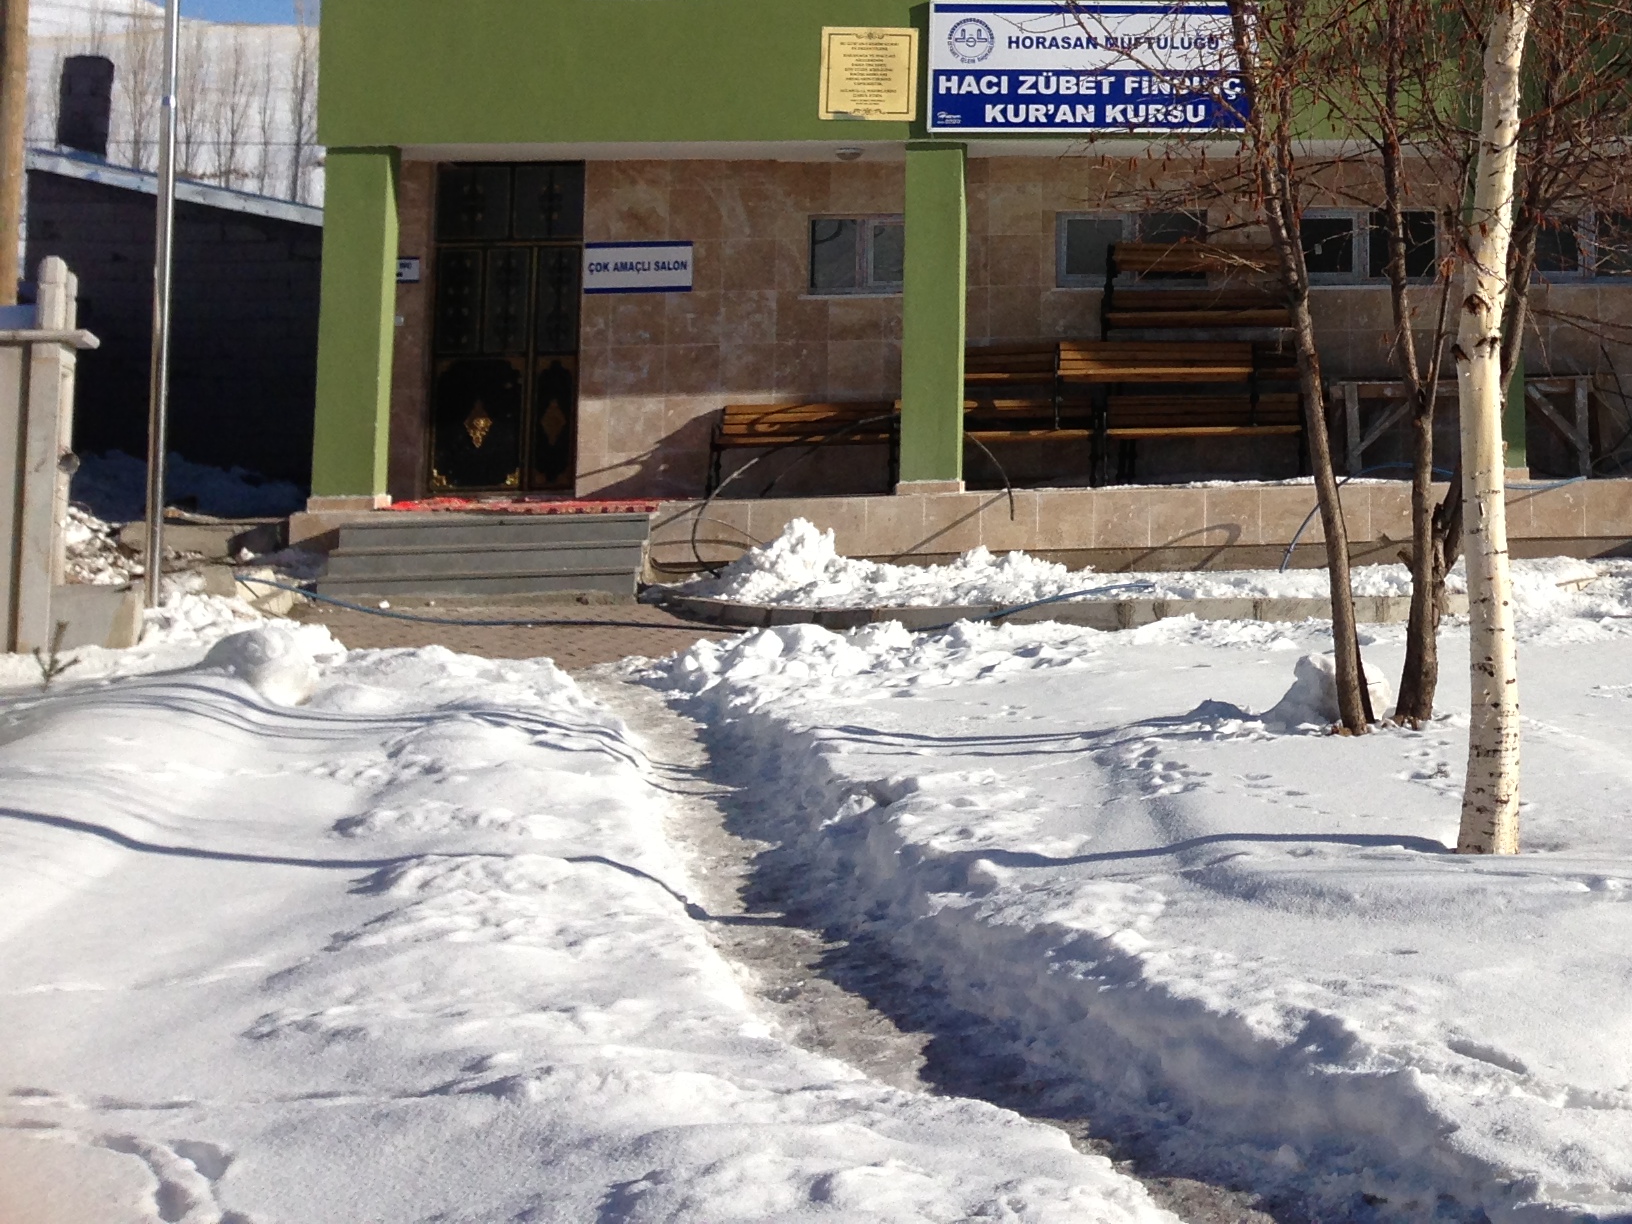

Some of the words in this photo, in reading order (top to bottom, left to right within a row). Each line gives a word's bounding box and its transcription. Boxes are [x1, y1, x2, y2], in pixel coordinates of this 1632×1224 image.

[1008, 36, 1098, 50] HORASAN
[939, 75, 1008, 94] HACI
[1018, 72, 1114, 94] ZÜBET
[1106, 104, 1205, 123] KURSU
[588, 262, 609, 275] ÇOK
[613, 261, 651, 274] AMAÇLI
[654, 260, 688, 272] SALON
